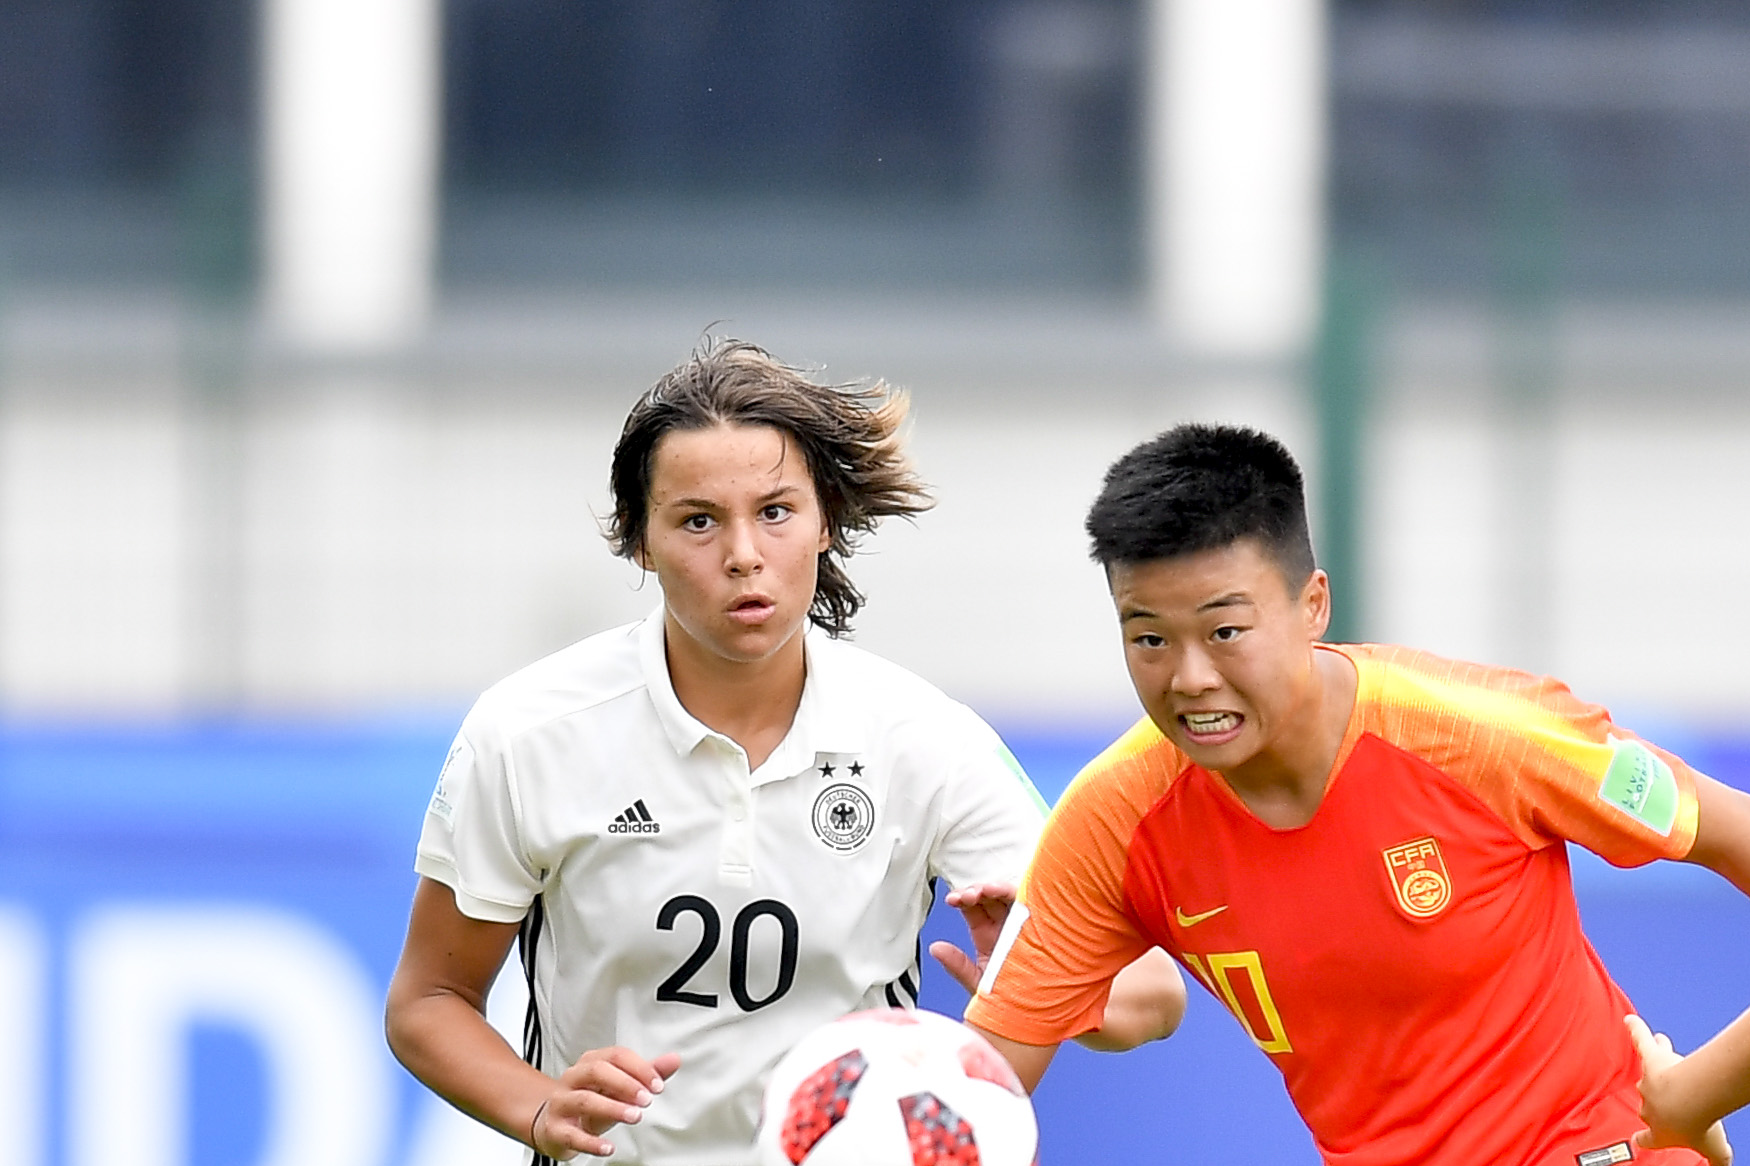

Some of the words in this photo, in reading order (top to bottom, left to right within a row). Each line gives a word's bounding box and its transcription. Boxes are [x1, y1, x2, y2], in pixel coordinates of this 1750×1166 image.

[607, 819, 661, 834] adidas
[1390, 843, 1436, 867] CFA
[656, 894, 799, 1012] 20
